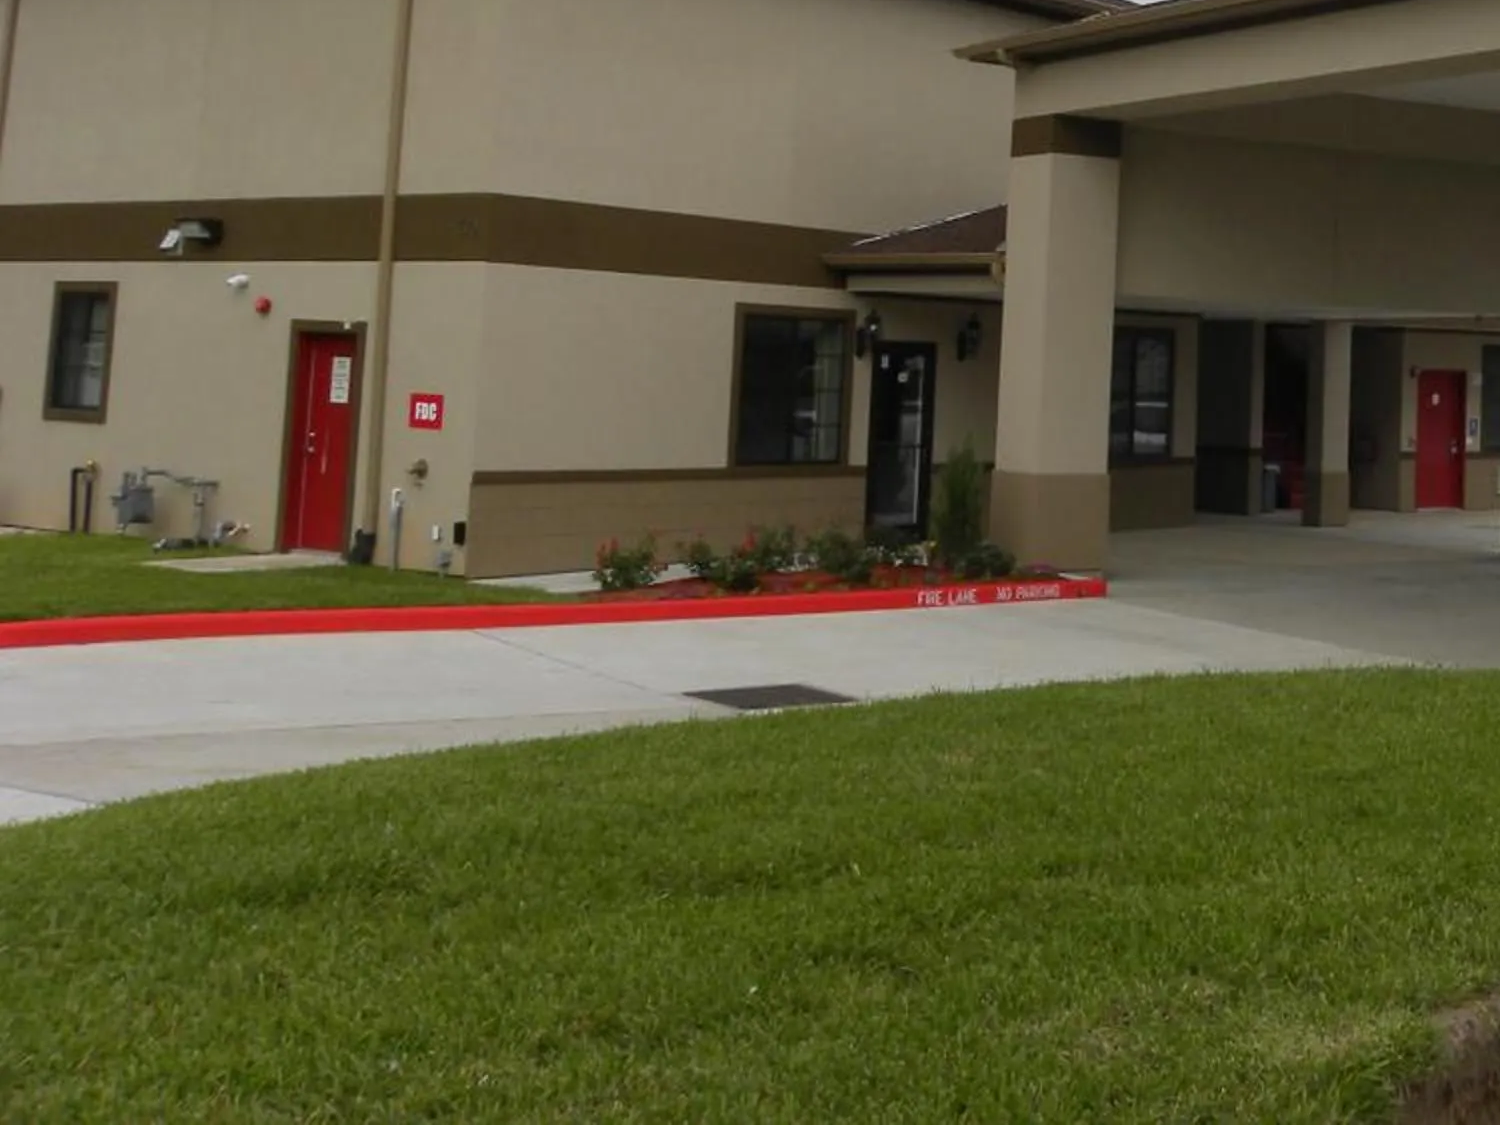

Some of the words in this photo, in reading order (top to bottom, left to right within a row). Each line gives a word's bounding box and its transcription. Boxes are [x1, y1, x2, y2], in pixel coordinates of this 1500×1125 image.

[415, 402, 437, 421] FDC
[918, 590, 943, 605] FIRE
[948, 588, 977, 605] LANE
